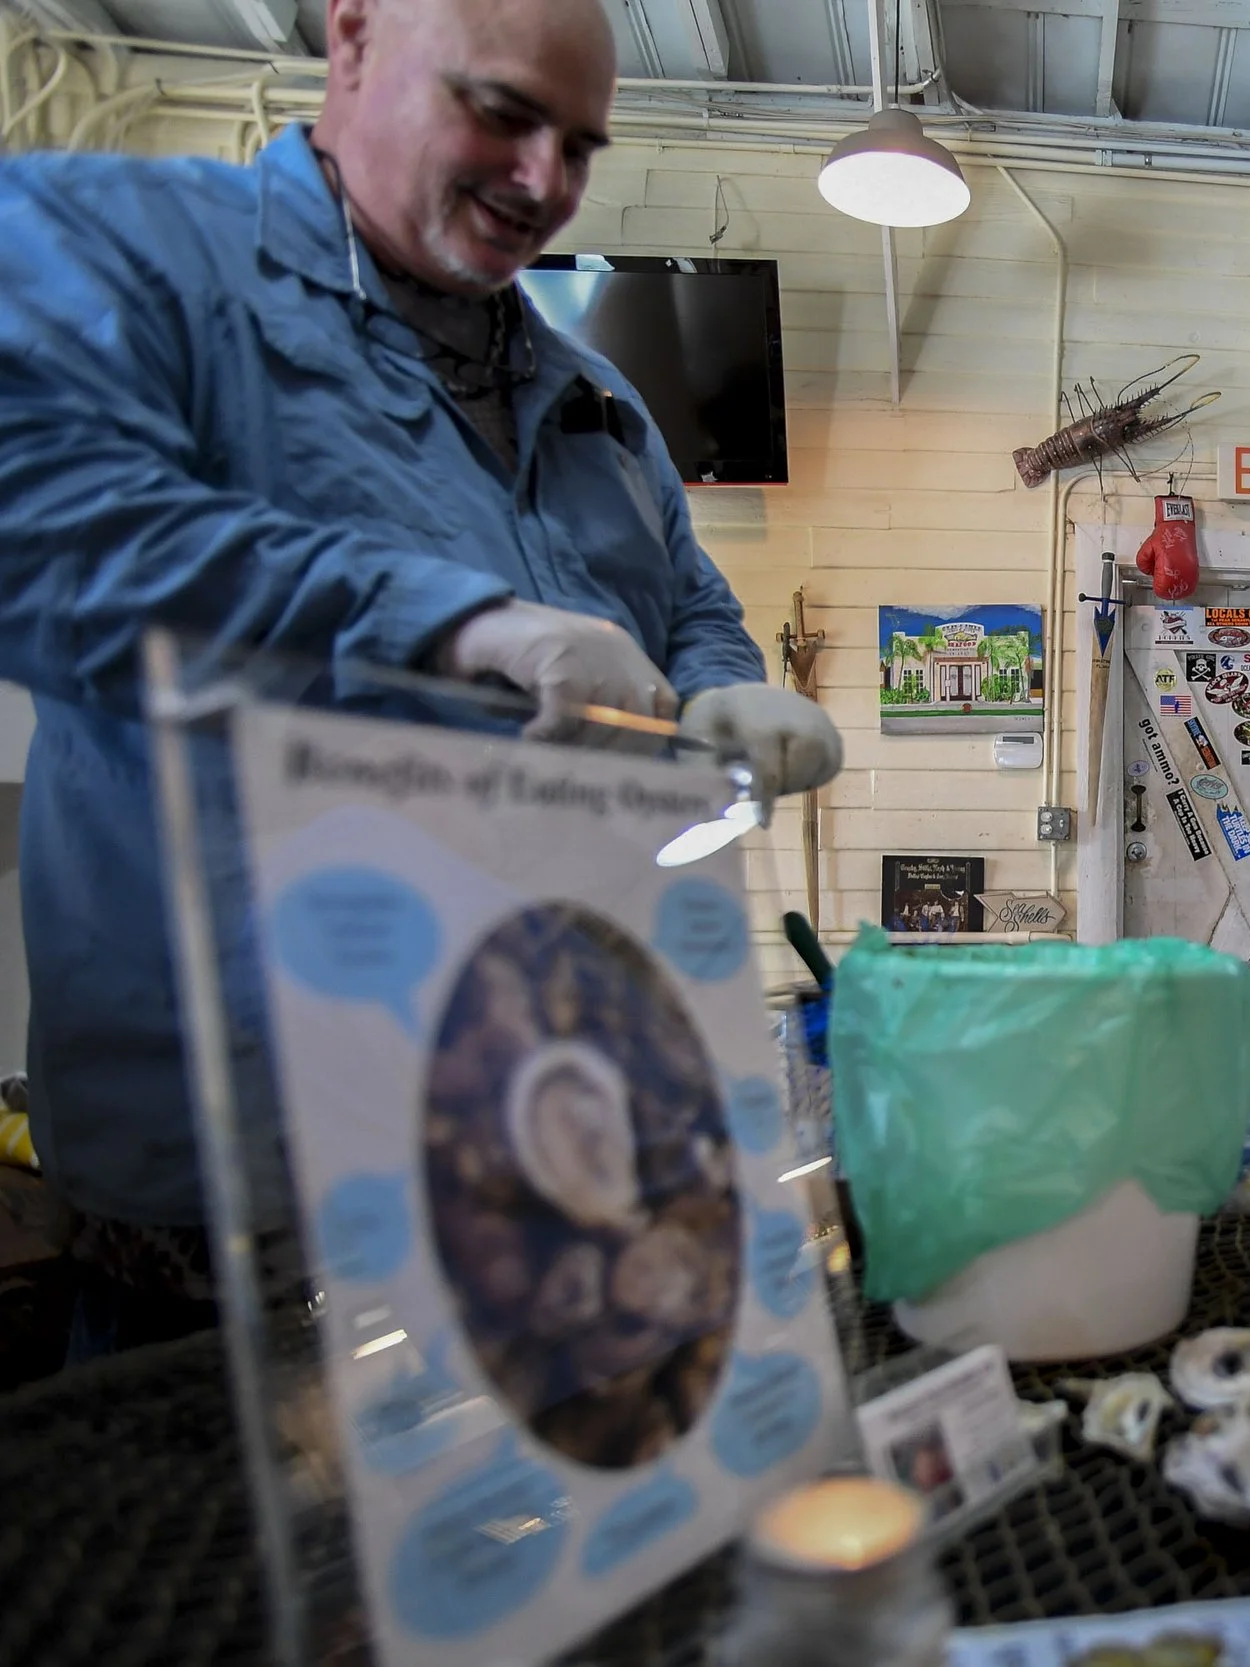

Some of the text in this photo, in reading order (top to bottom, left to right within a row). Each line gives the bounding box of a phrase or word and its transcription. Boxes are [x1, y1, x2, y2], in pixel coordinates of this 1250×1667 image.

[1206, 608, 1246, 619] LOCALS
[1155, 674, 1177, 683] ATF
[1138, 718, 1180, 785] got ammo?
[1180, 794, 1191, 812] Carry
[1190, 817, 1198, 830] Gun
[1195, 829, 1210, 855] Because
[1184, 823, 1193, 836] Too
[1189, 835, 1200, 854] Heavy
[1221, 815, 1232, 831] THE
[1229, 813, 1247, 845] TURTLES
[1000, 899, 1056, 933] Sea Shells
